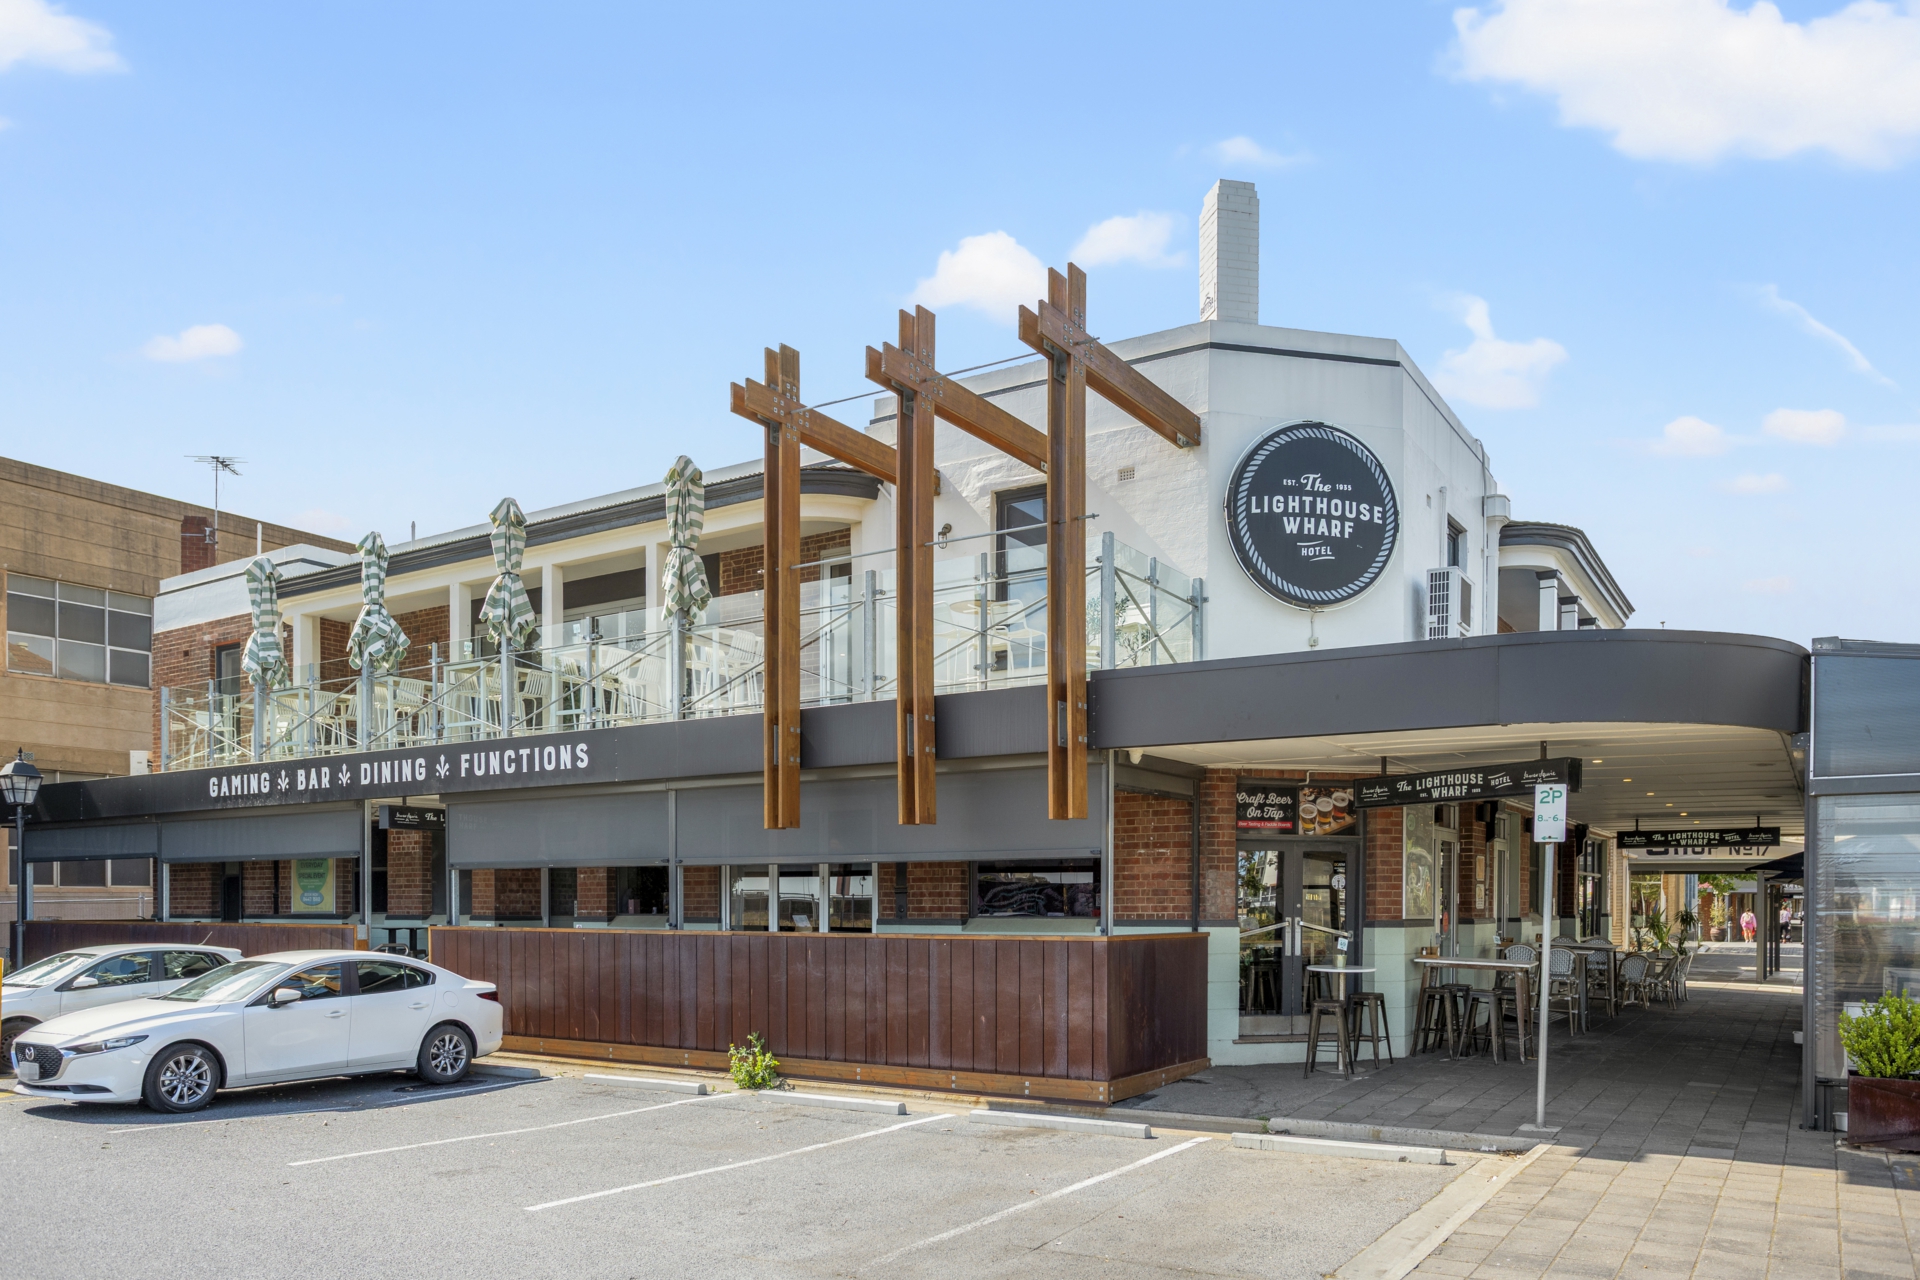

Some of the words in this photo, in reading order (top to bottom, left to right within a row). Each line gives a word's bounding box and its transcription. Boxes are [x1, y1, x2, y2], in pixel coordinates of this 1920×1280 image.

[1282, 479, 1299, 487] EST.
[1300, 473, 1332, 492] The
[1251, 495, 1383, 524] LIGHTHOUSE
[1282, 516, 1354, 538] WHARF
[1301, 546, 1332, 556] HOTEL
[209, 772, 270, 797] GAMING
[297, 766, 330, 790] BAR
[360, 757, 426, 785] DINING
[460, 742, 589, 778] FUNCTIONS
[1396, 780, 1413, 792] The
[1416, 773, 1484, 790] LIGHTHOUSE
[1490, 775, 1511, 786] HOTEL
[1431, 785, 1468, 799] WHARF
[1539, 790, 1563, 804] 2P
[1236, 792, 1266, 807] Craft
[1266, 792, 1293, 805] Beer
[424, 812, 438, 821] The
[1246, 807, 1262, 818] On
[1263, 806, 1285, 820] Tap
[1652, 833, 1665, 841] The
[1667, 831, 1720, 840] LIGHTHOUSE
[1679, 838, 1708, 846] WHARF
